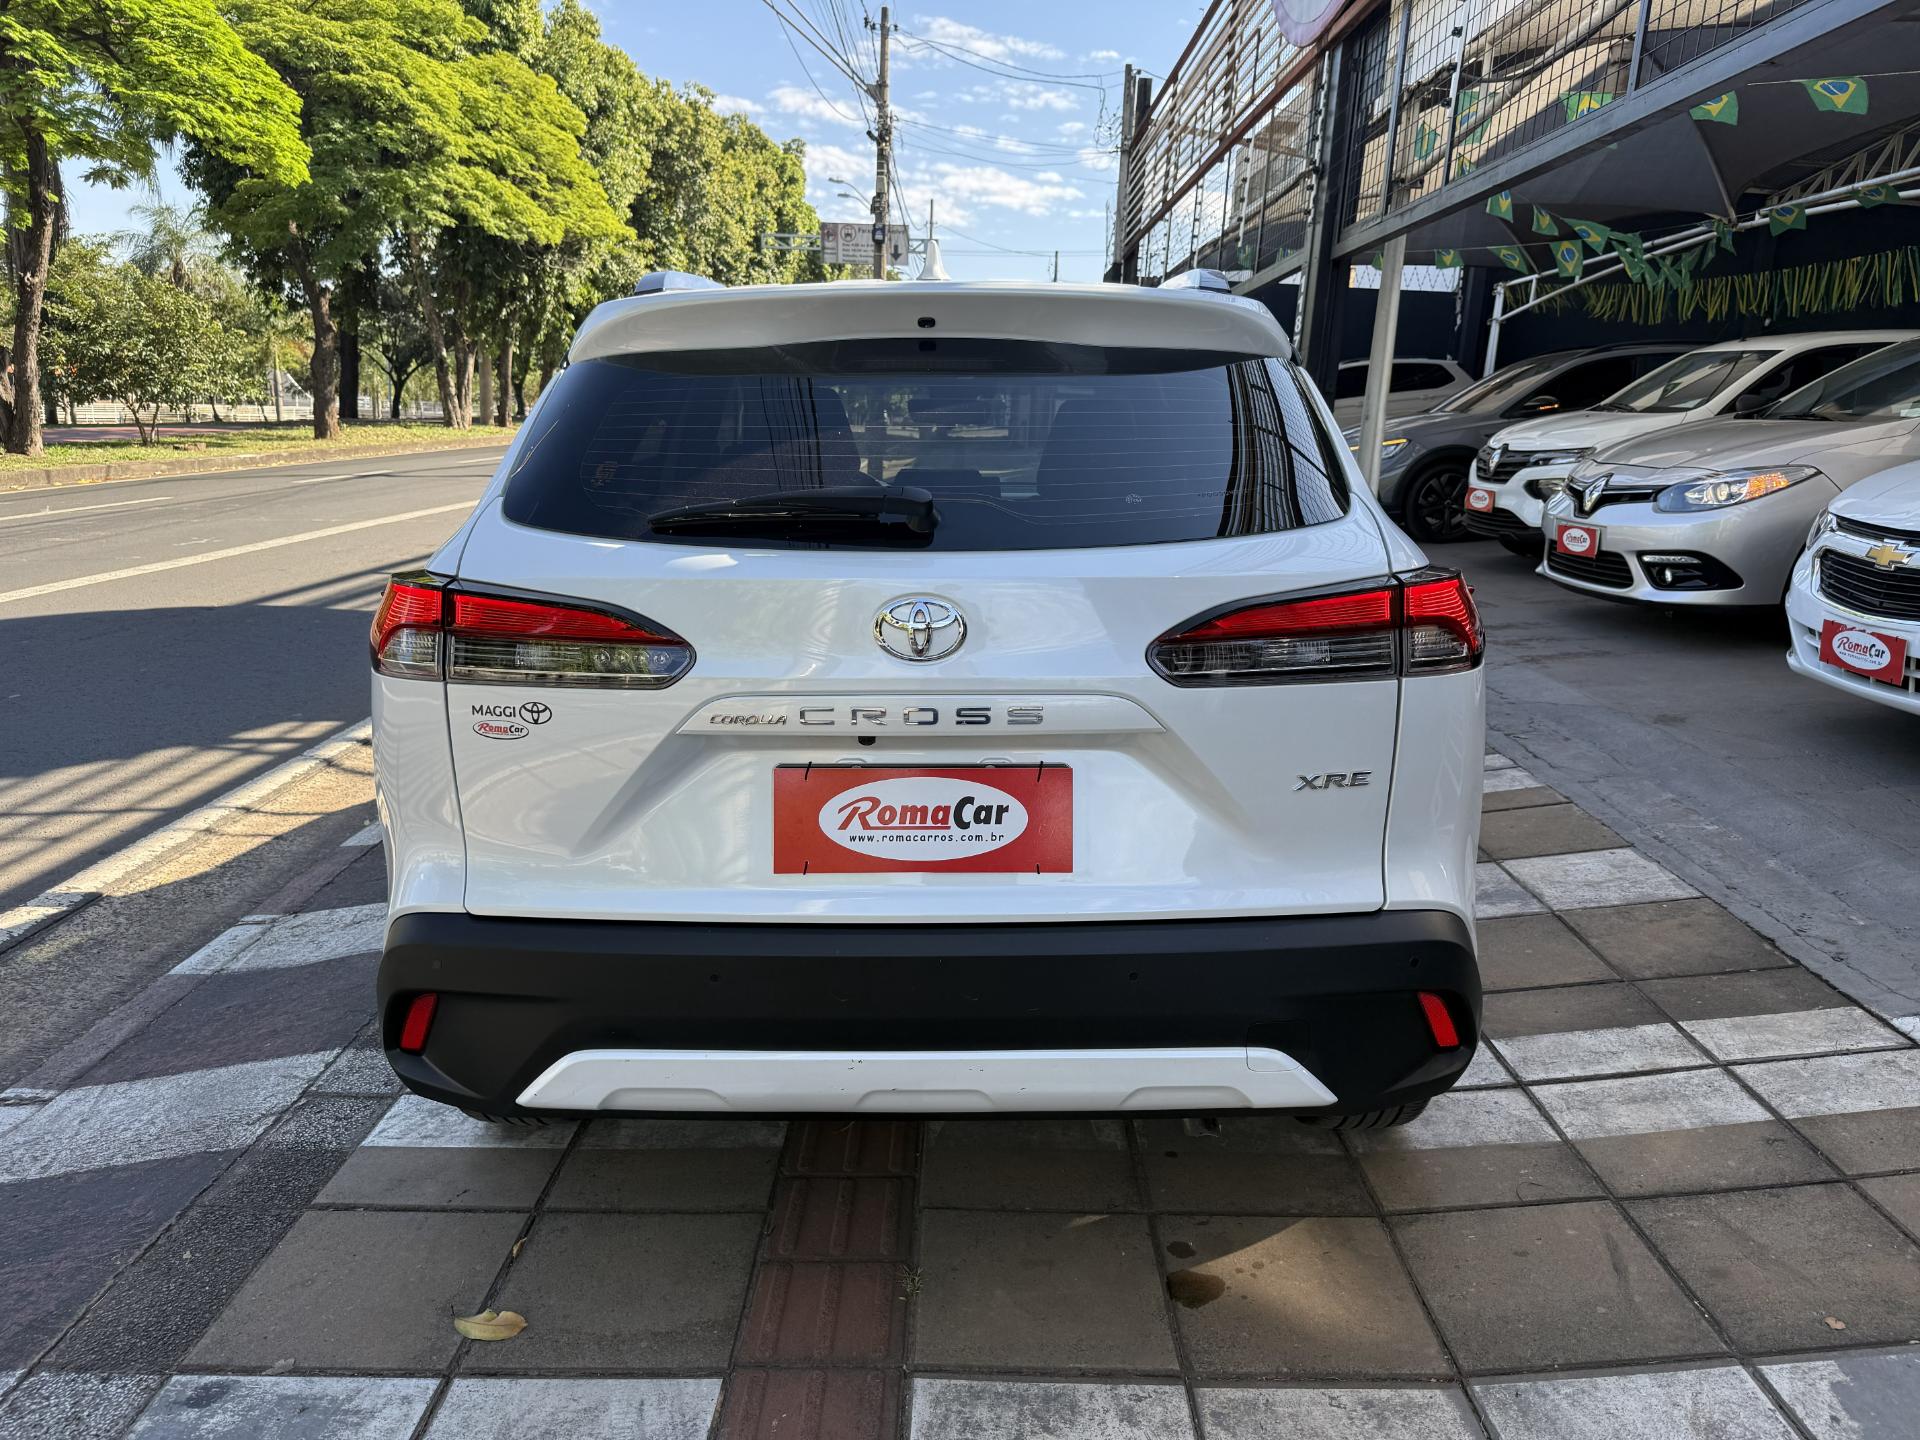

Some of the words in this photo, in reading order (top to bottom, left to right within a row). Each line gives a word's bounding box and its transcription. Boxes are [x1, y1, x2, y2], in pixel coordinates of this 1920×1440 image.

[1837, 636, 1886, 659] RomaCar
[471, 704, 517, 718] MAGGI
[709, 714, 788, 726] COROLLA
[799, 705, 1044, 726] CROSS
[477, 722, 525, 734] RomaCar
[1291, 769, 1372, 791] XRE
[836, 795, 1010, 831] RomaCar
[848, 831, 1006, 844] www.romacarros.com.br
